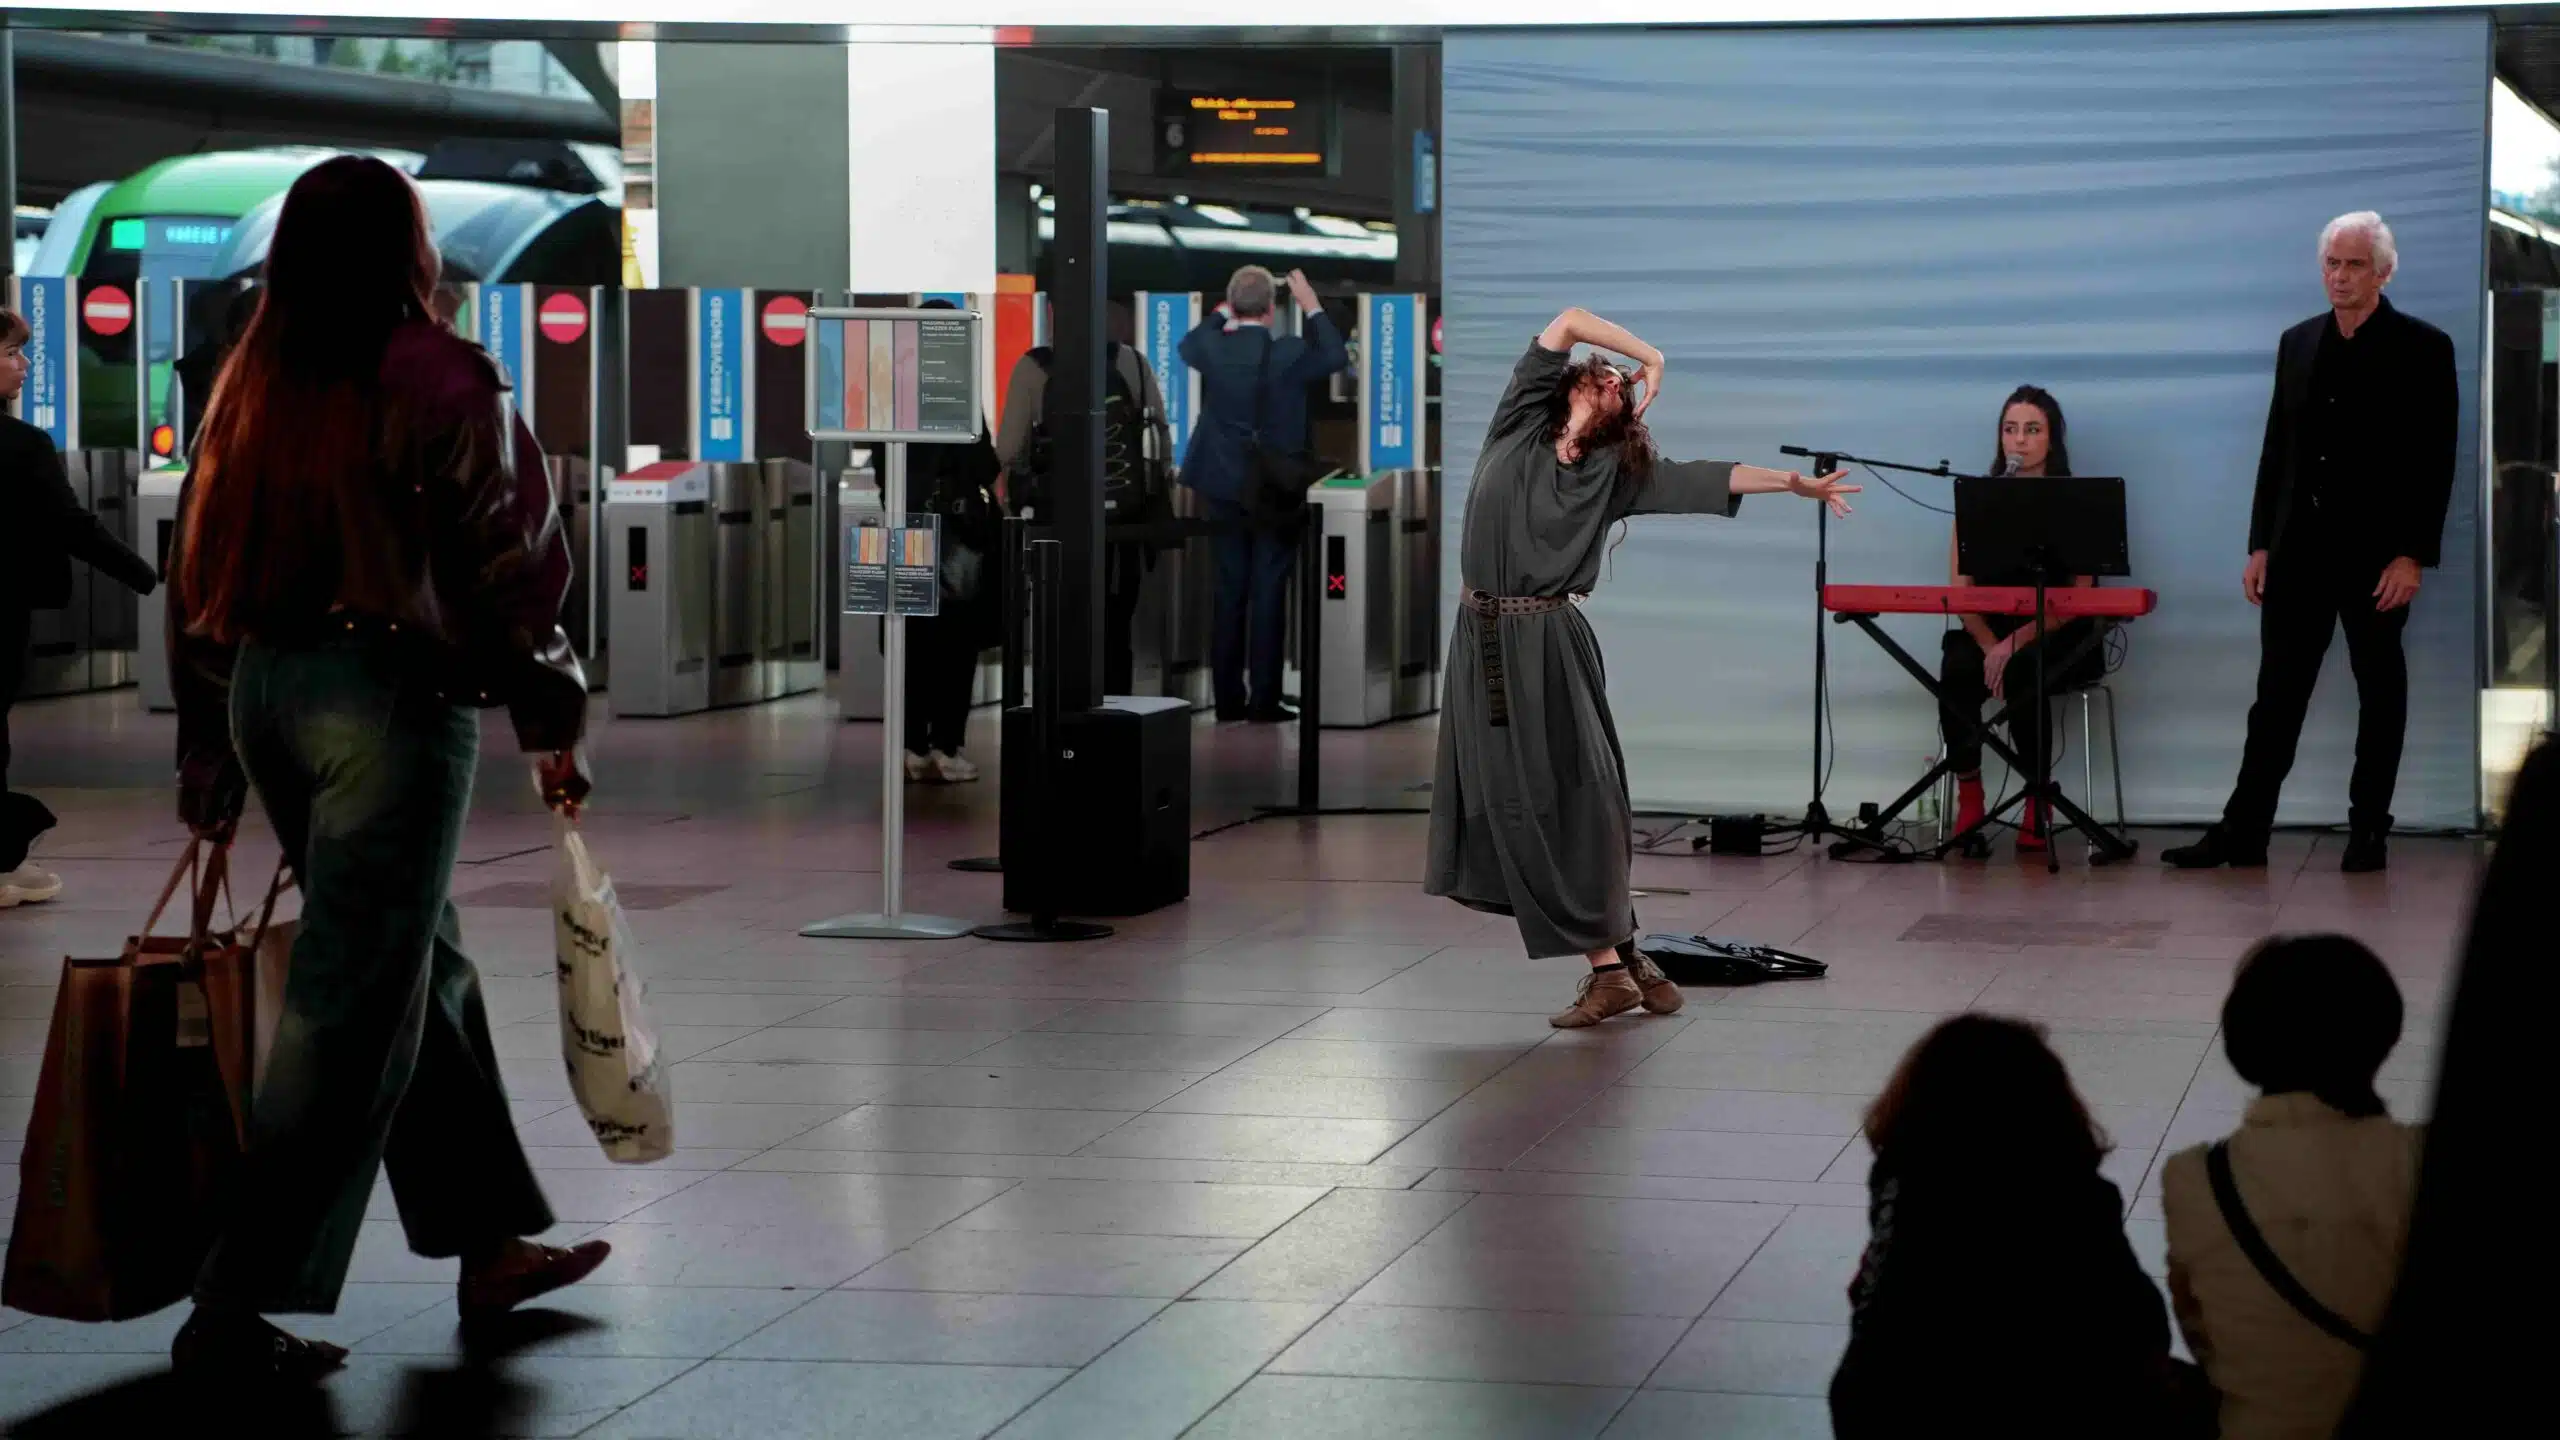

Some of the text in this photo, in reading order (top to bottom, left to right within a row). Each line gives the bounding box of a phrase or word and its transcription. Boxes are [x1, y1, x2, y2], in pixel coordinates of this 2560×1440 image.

[32, 283, 46, 403] FERROVIENORD
[489, 290, 503, 360] VIENORD
[710, 295, 723, 415] FERROVIENORD
[1380, 302, 1394, 422] FERROVIENORD
